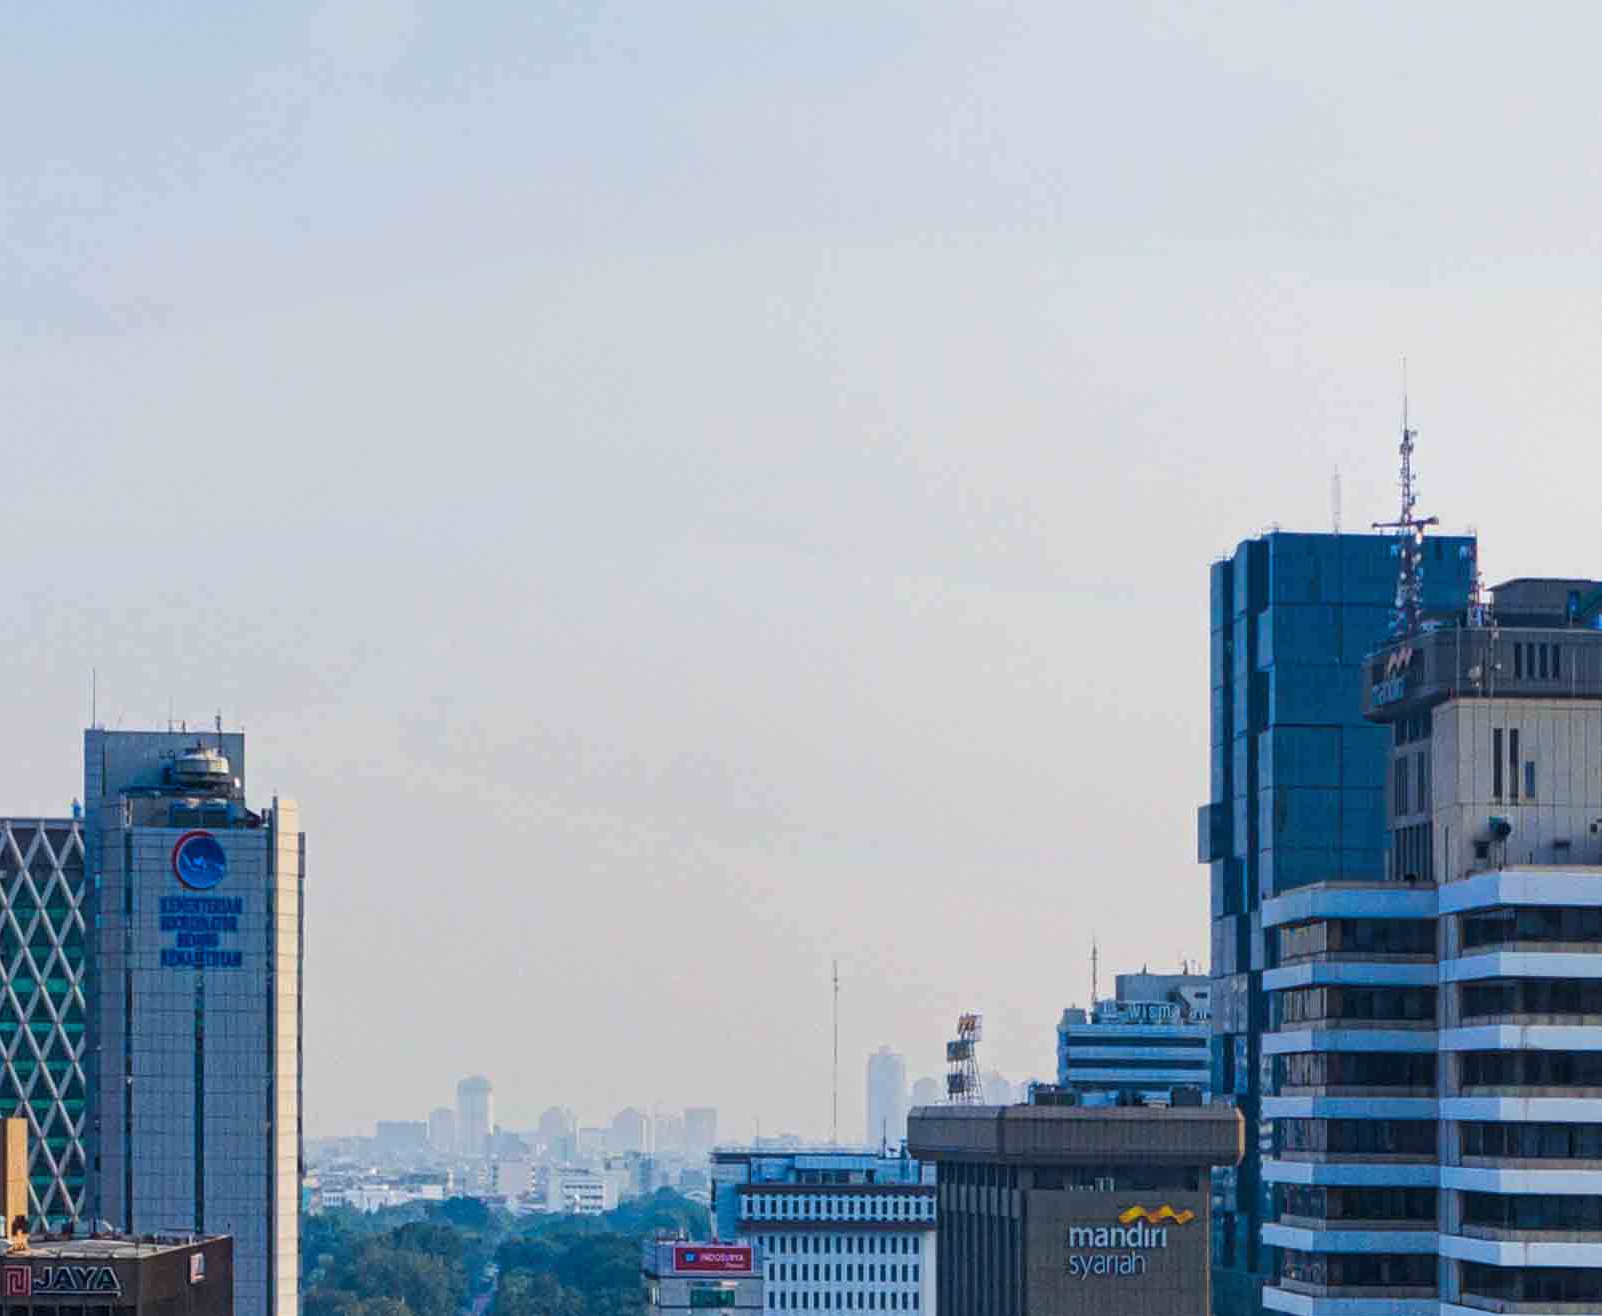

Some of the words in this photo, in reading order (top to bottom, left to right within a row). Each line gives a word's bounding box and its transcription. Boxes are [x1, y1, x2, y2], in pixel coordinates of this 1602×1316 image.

[1069, 1221, 1167, 1248] mandiri
[33, 1265, 120, 1290] JAYA
[1069, 1250, 1146, 1280] syariah
